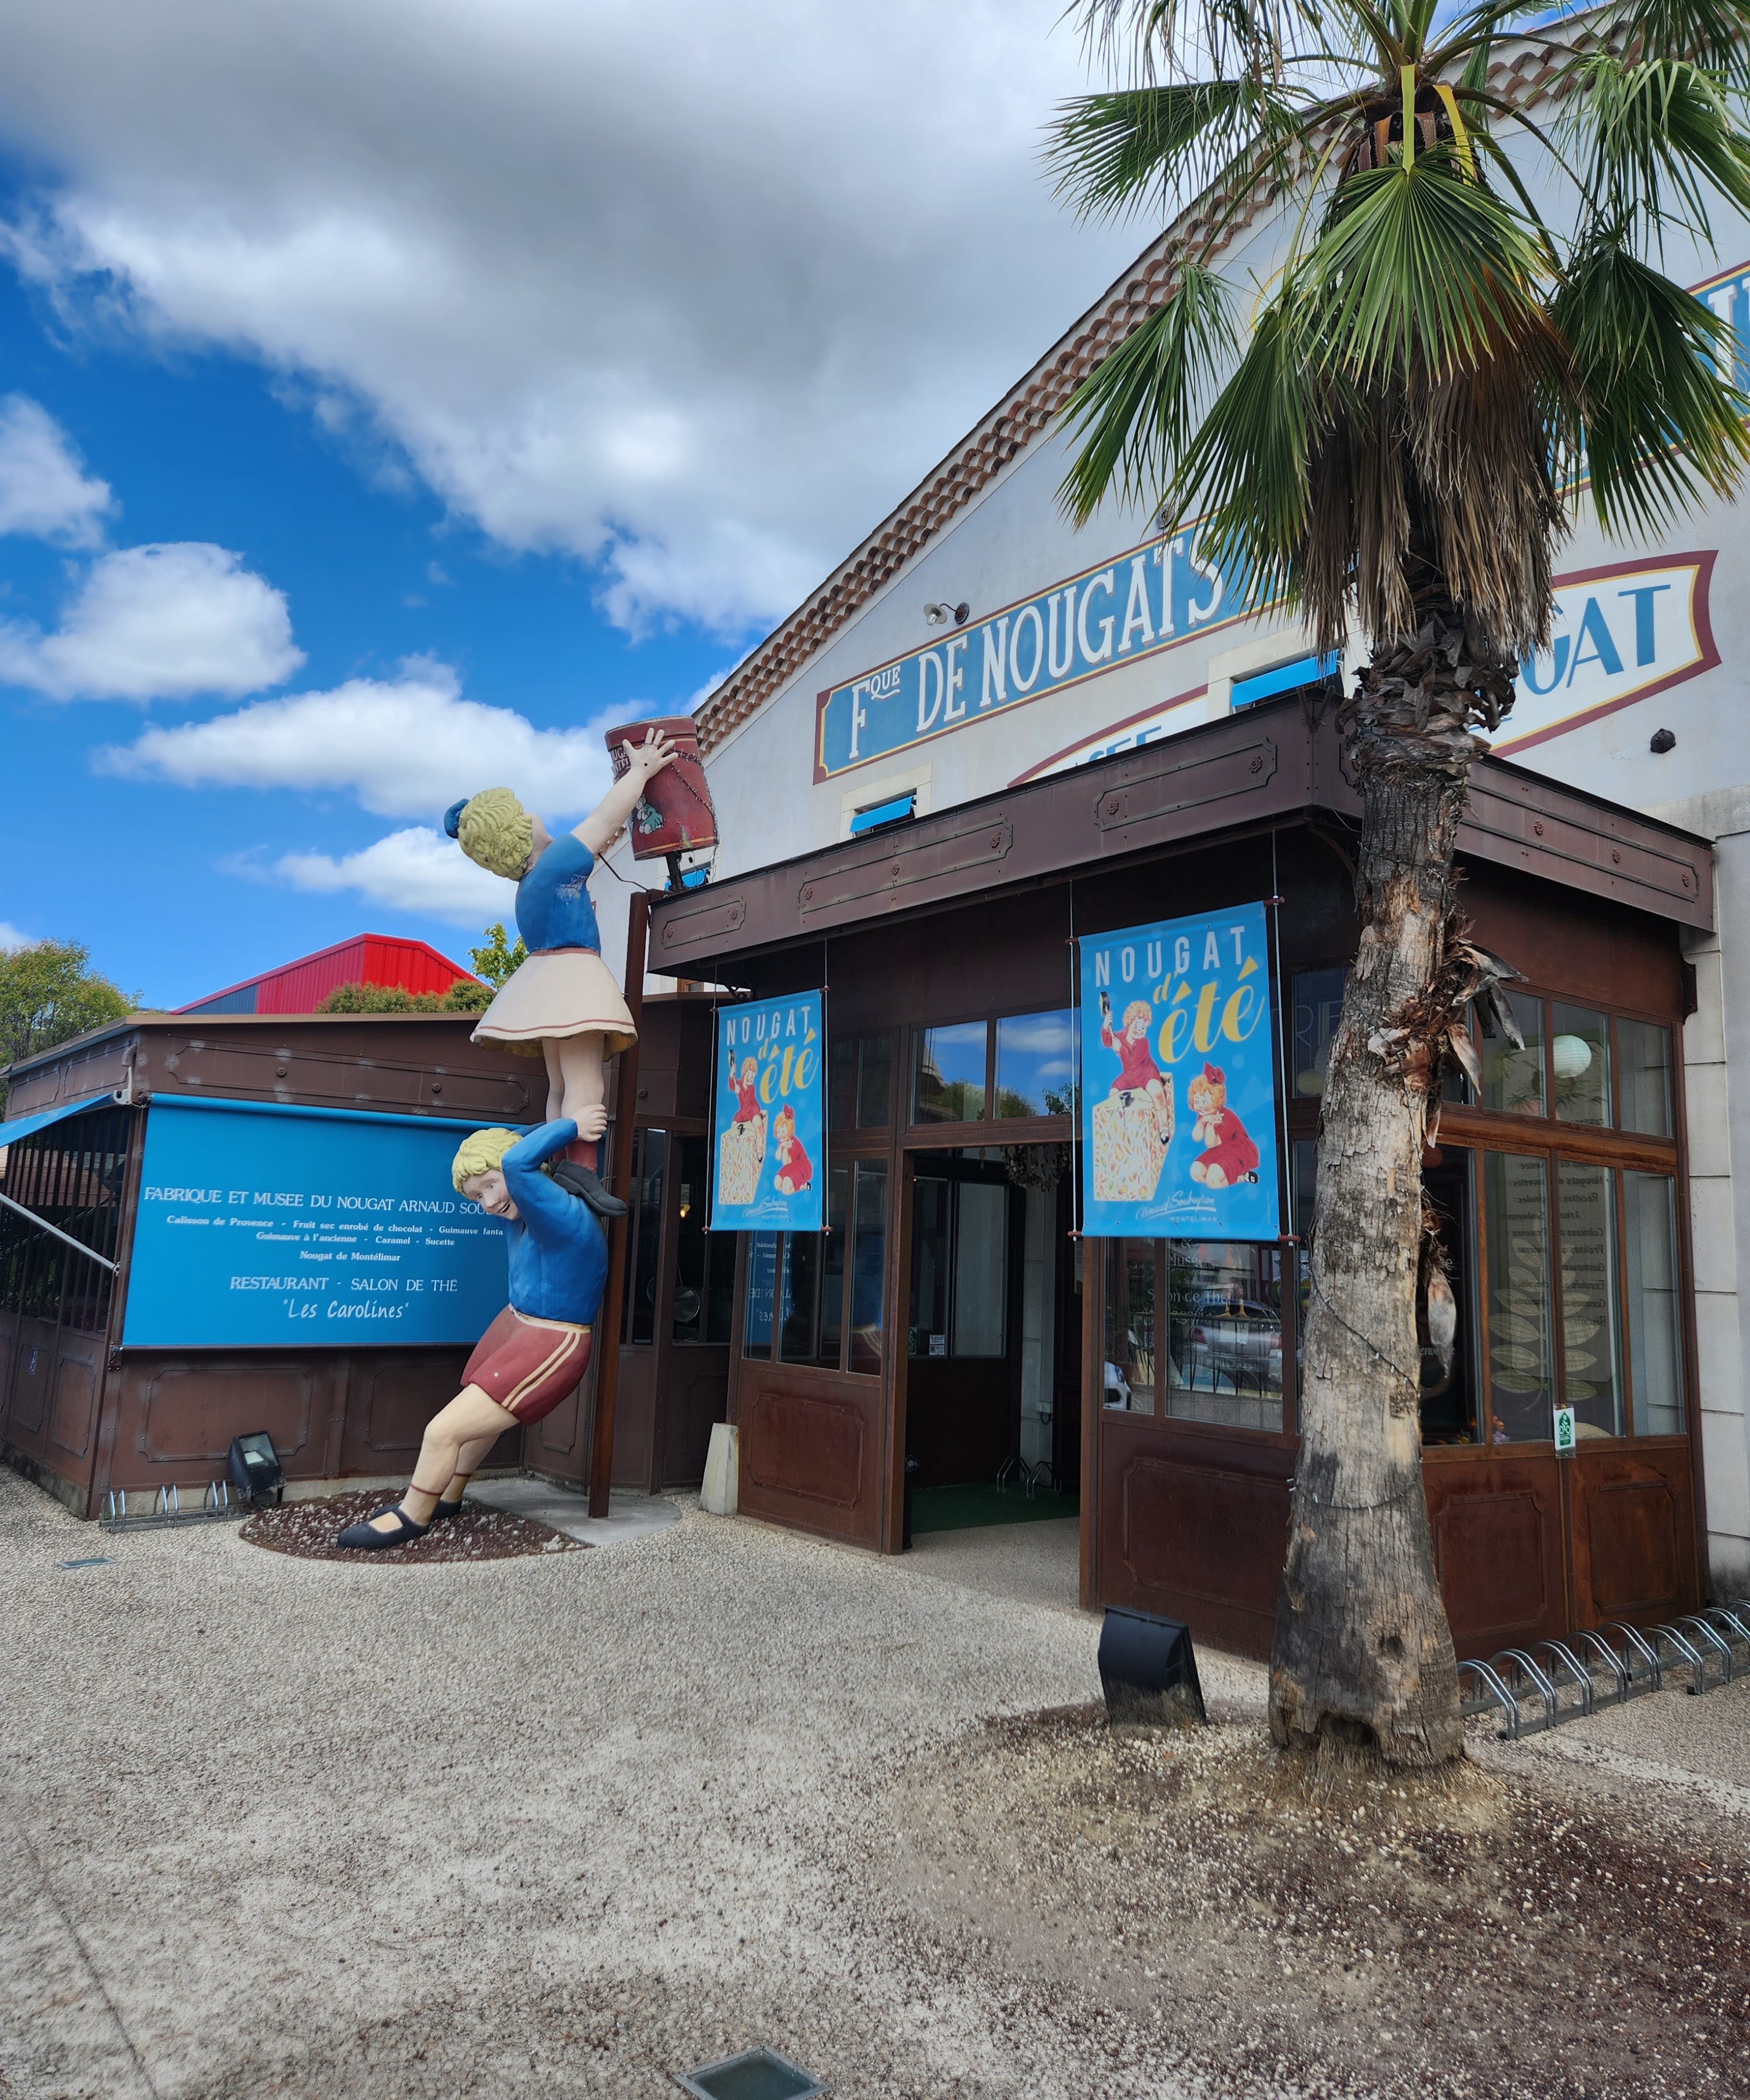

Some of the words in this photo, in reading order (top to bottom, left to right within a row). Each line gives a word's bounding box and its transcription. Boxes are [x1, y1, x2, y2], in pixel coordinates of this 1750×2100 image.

[916, 635, 968, 733] DE
[980, 524, 1224, 708] NOUGATS
[1095, 926, 1245, 987] NOUGAT
[727, 1006, 811, 1046] NOUGAT
[144, 1186, 222, 1203] FABRIQUE
[228, 1191, 249, 1203] ET
[253, 1192, 304, 1206] MUSEE
[310, 1195, 332, 1208] DU
[337, 1196, 395, 1210] NOUGAT
[398, 1199, 455, 1213] ARNAUD
[166, 1214, 209, 1226] Calisson
[213, 1217, 226, 1226] de
[229, 1217, 274, 1227] Provence
[293, 1220, 316, 1229] Fruit
[339, 1222, 369, 1231] enrobé
[373, 1224, 384, 1232] de
[388, 1224, 423, 1233] chocolat
[439, 1226, 478, 1235] Guimauve
[483, 1227, 503, 1236] fanta
[256, 1231, 301, 1241] Guimauve
[303, 1232, 310, 1241] à
[313, 1234, 357, 1242] l'ancienne
[375, 1236, 411, 1244] Caramel
[425, 1237, 455, 1246] Sucette
[300, 1251, 332, 1261] Nougat
[337, 1252, 348, 1260] de
[351, 1252, 401, 1261] Montélimar
[230, 1276, 329, 1290] RESTAURANT
[351, 1279, 398, 1290] SALON
[406, 1279, 424, 1291] DE
